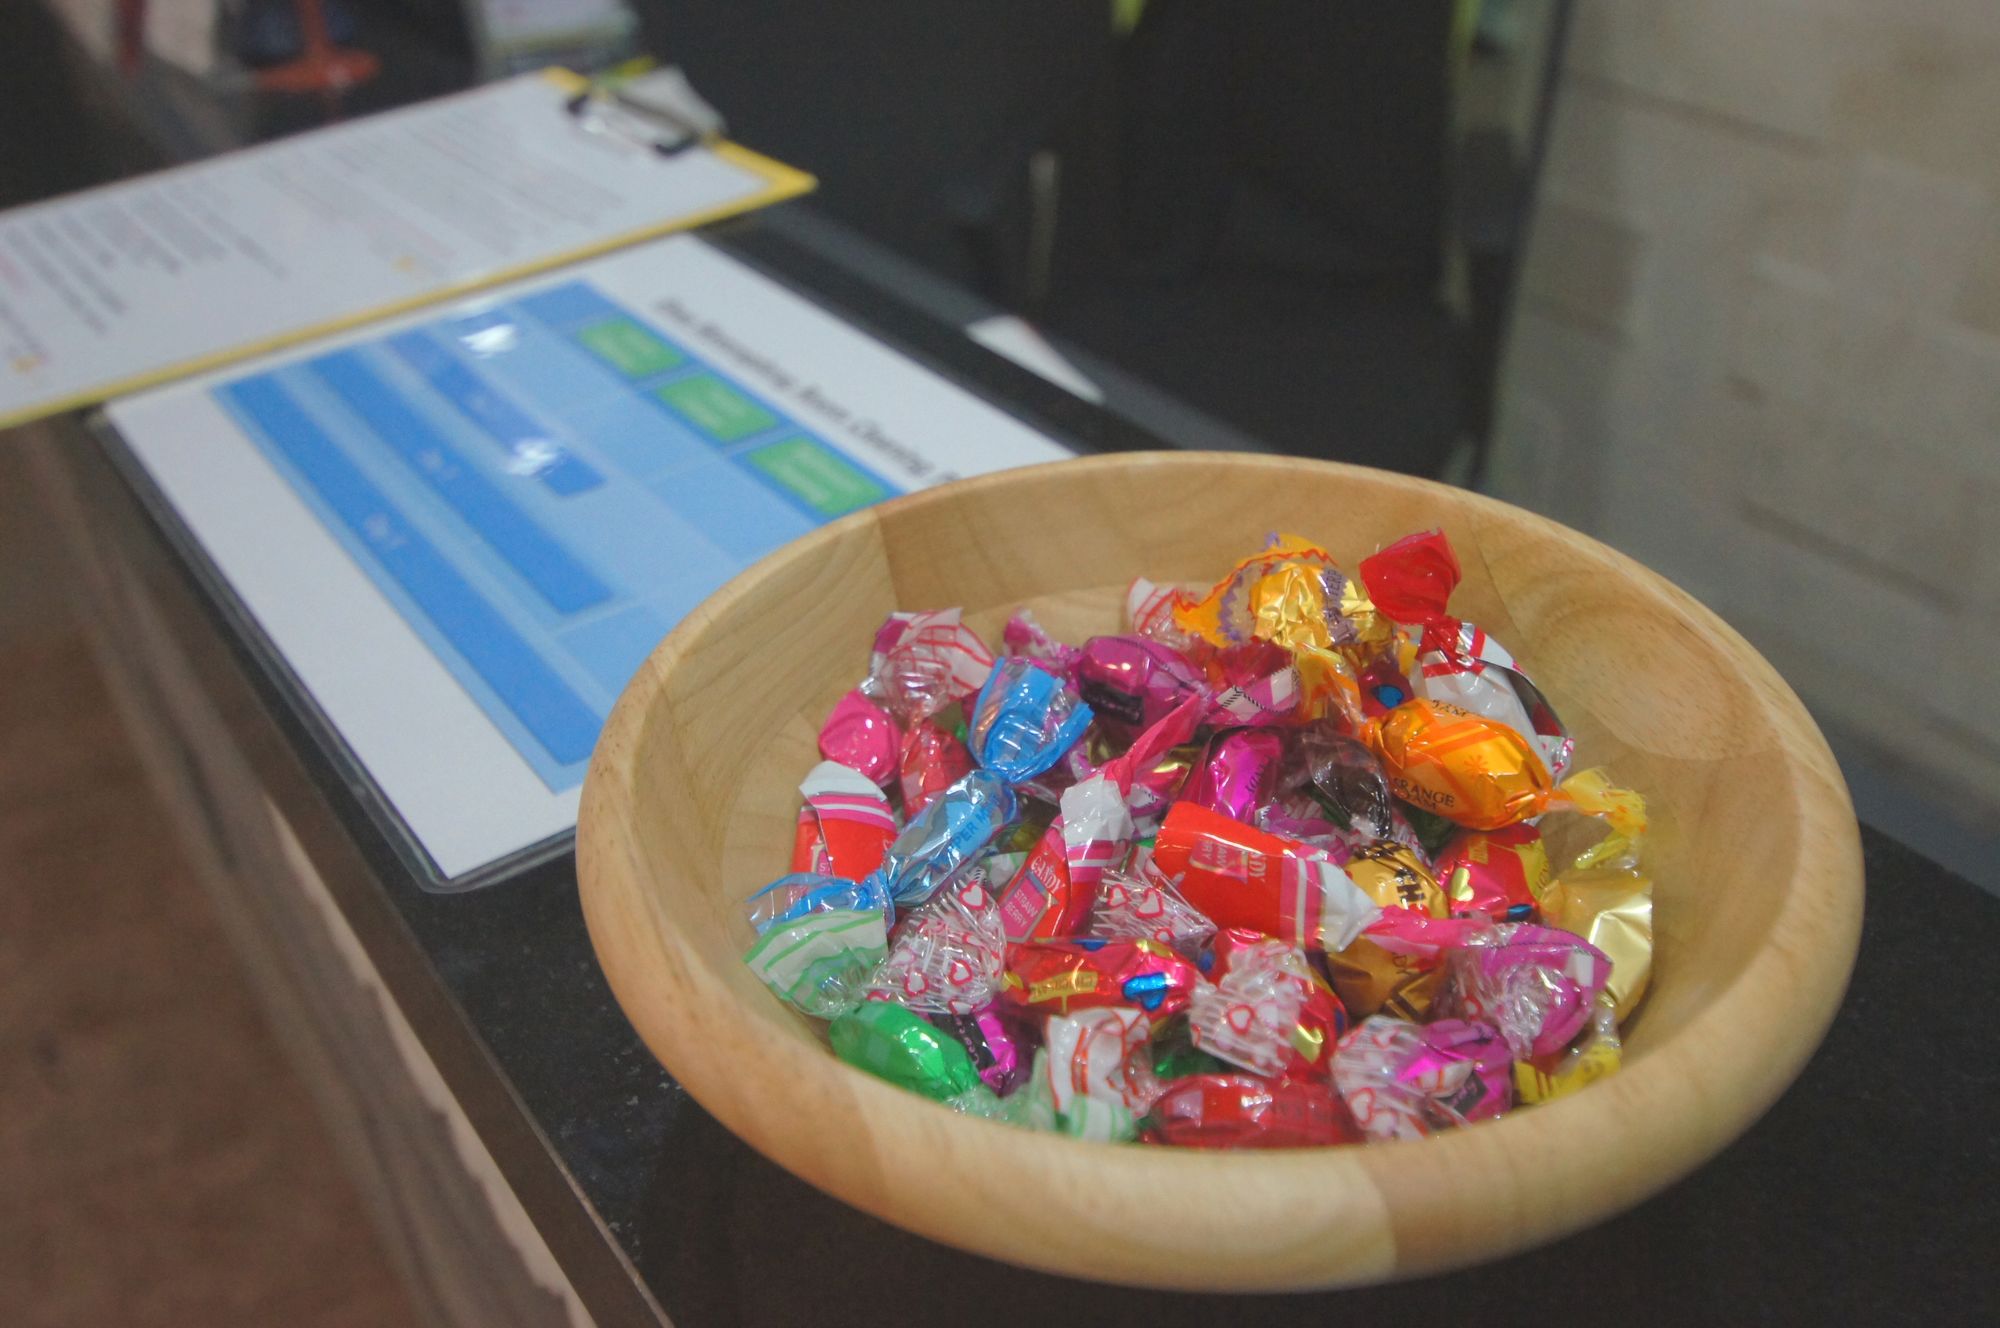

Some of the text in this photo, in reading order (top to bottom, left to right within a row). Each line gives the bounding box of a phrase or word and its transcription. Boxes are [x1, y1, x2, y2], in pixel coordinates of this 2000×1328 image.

[1030, 855, 1061, 895] CANDY
[1004, 901, 1028, 928] BERRY
[1013, 888, 1039, 918] STRAW
